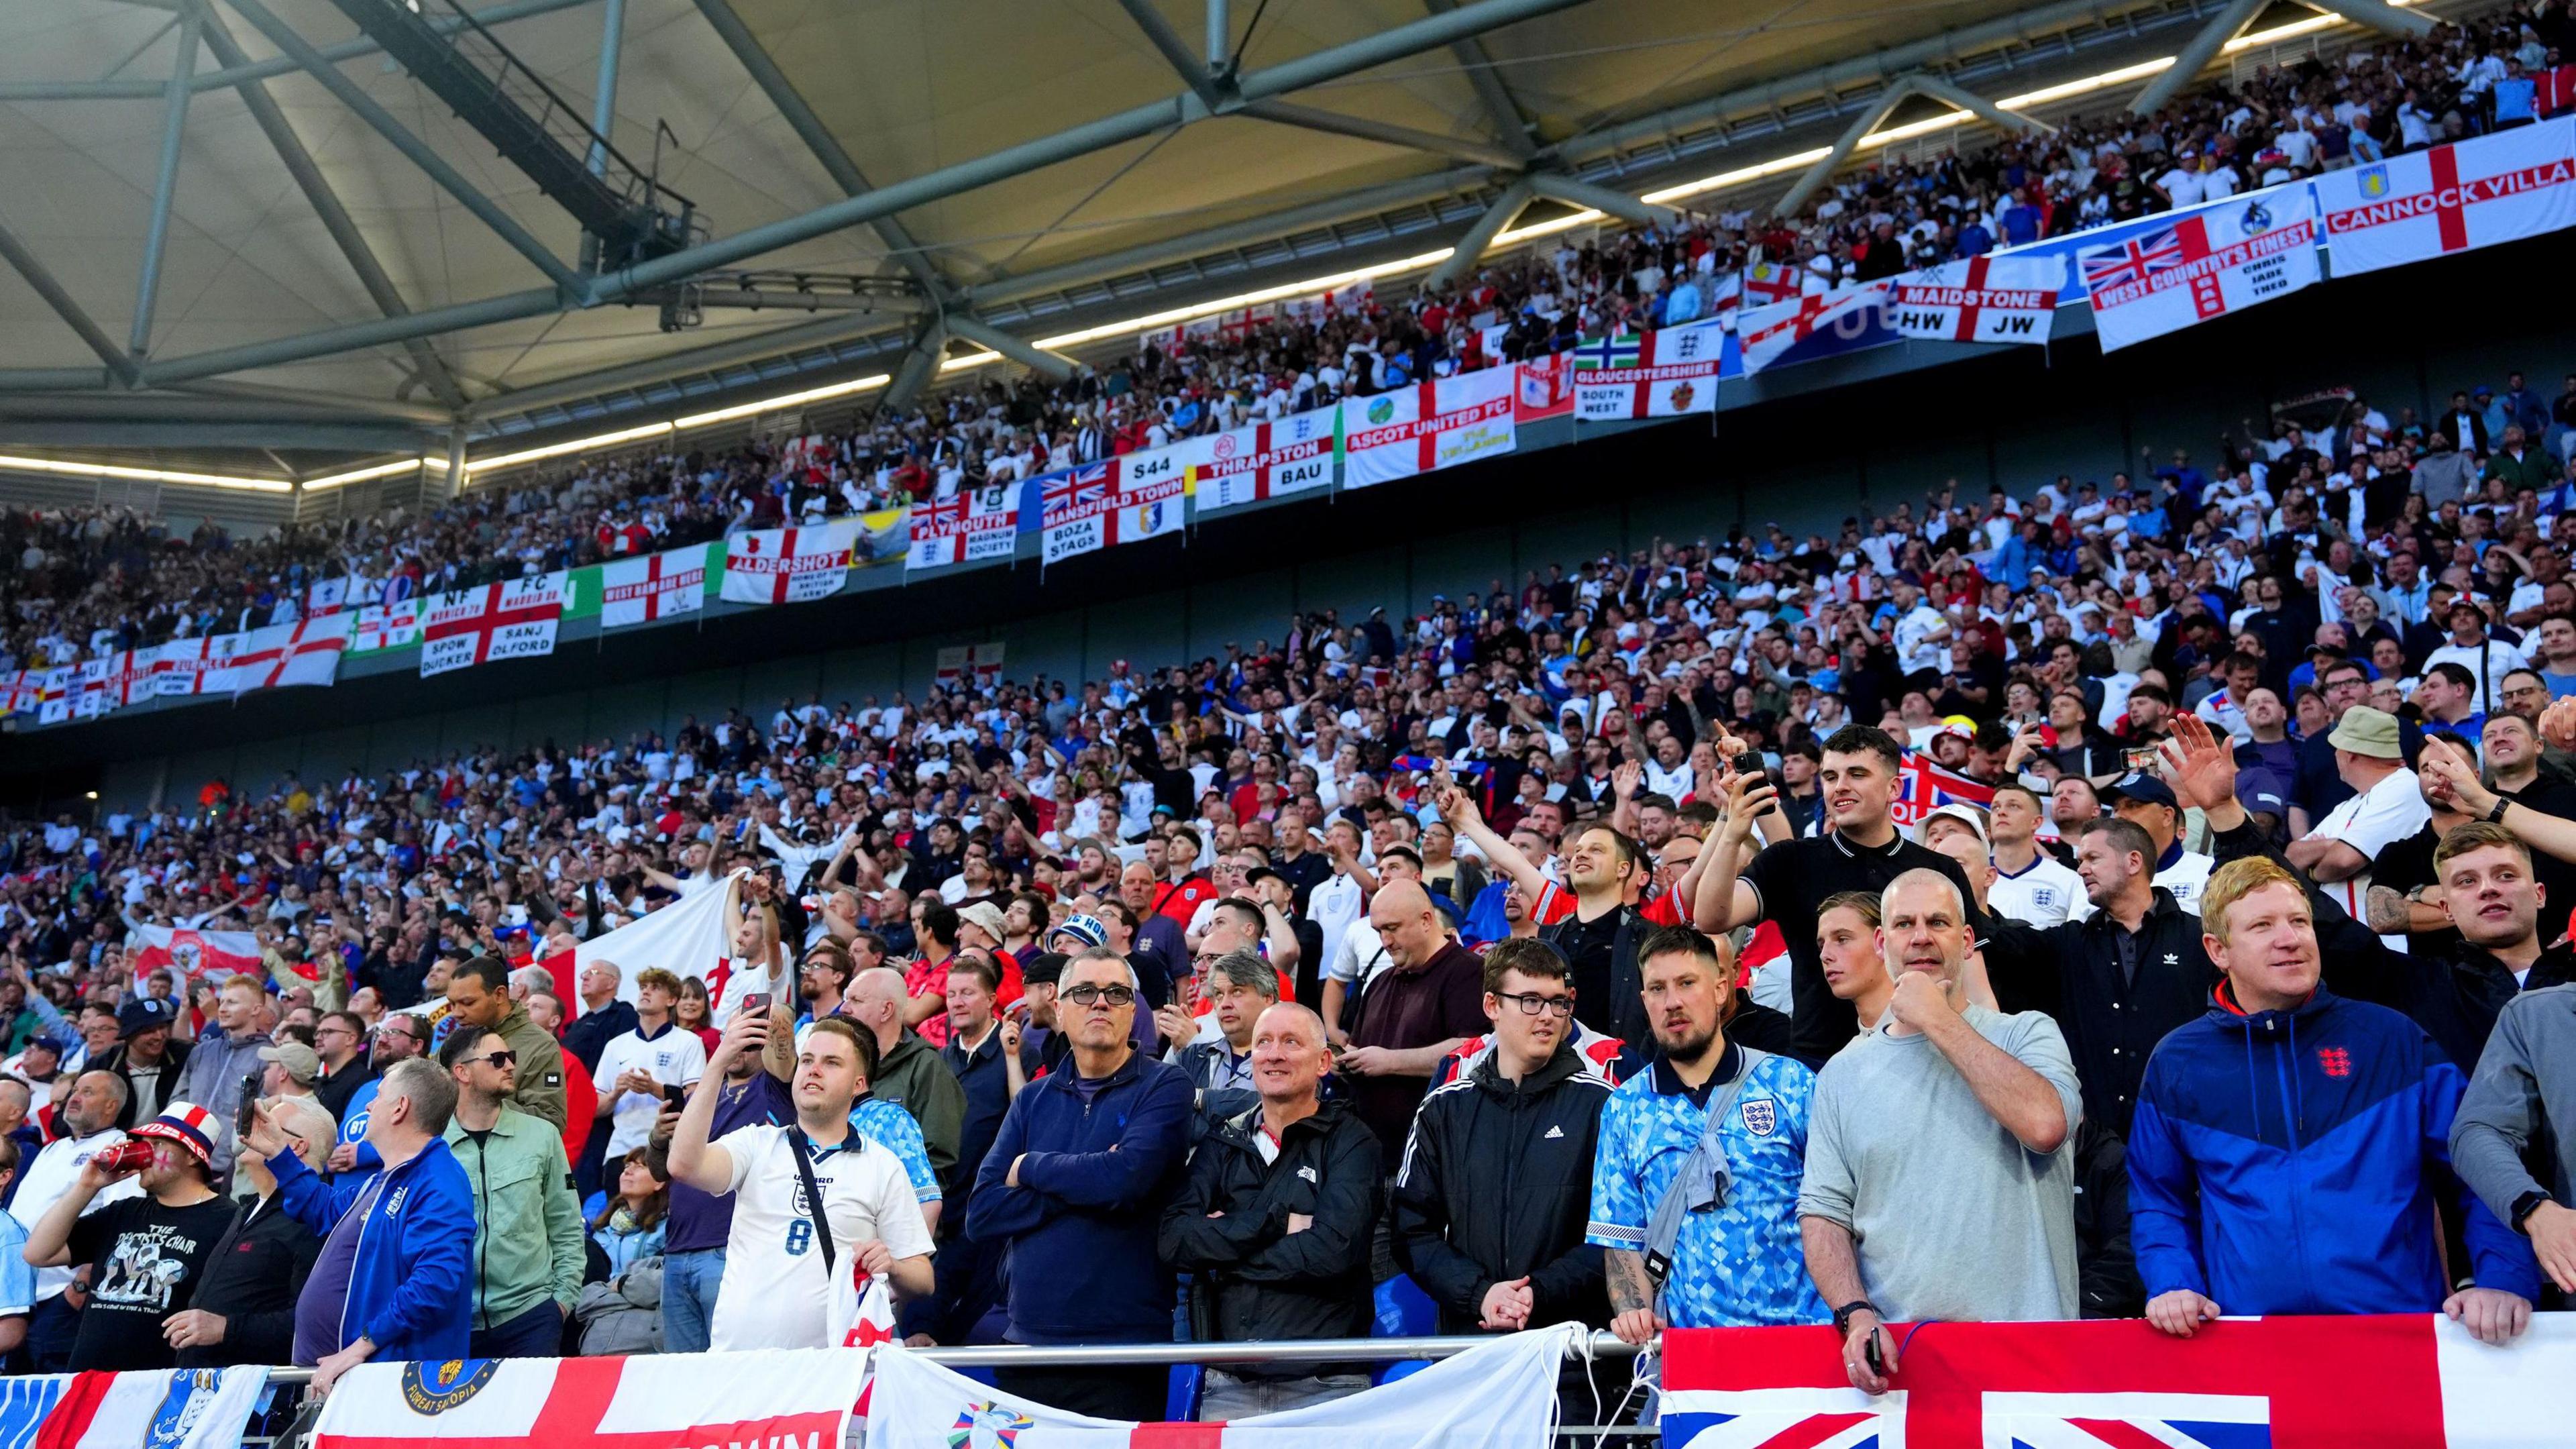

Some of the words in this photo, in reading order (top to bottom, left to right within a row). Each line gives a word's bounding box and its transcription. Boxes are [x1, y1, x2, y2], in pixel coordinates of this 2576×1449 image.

[2332, 184, 2479, 233] CANNOCK
[2485, 163, 2571, 197] VILLA
[2100, 279, 2147, 309] WEST
[2151, 246, 2247, 289] COUNTRY'S
[2251, 223, 2310, 259] FINEST
[1905, 288, 2042, 308] MAIDSTONE
[1900, 311, 1944, 330] HW
[1992, 317, 2034, 334] JW
[1576, 362, 1715, 384] GLOUCESTERSHIRE
[1582, 389, 1625, 400] SOUTH
[1585, 402, 1619, 413] WEST
[1350, 425, 1409, 449] ASCOT
[1413, 409, 1481, 436] UNITED
[1485, 399, 1507, 416] FC
[1134, 457, 1170, 478] S44
[1210, 440, 1320, 477] THRAPSTON
[1282, 464, 1322, 484] BAU
[1044, 494, 1132, 529] MANSFIELD
[1136, 478, 1183, 502] TOWN
[918, 514, 1007, 539] PLYMOUTH
[1055, 522, 1093, 541] BOZA
[1051, 535, 1095, 557] STAGS
[733, 553, 843, 574] ALDERSHOT
[444, 590, 468, 606] NF
[521, 574, 547, 592] FC
[605, 586, 634, 602] WEST
[506, 625, 543, 639] SANJ
[432, 639, 468, 655] SPOW
[492, 639, 549, 656] OLFORD
[89, 663, 99, 676] U
[423, 652, 472, 672] DUCKER
[350, 1120, 367, 1135] BT
[149, 1224, 177, 1234] THE
[785, 1219, 812, 1256] 8
[165, 1234, 197, 1254] CHAIR
[407, 1384, 435, 1412] FLOREAT
